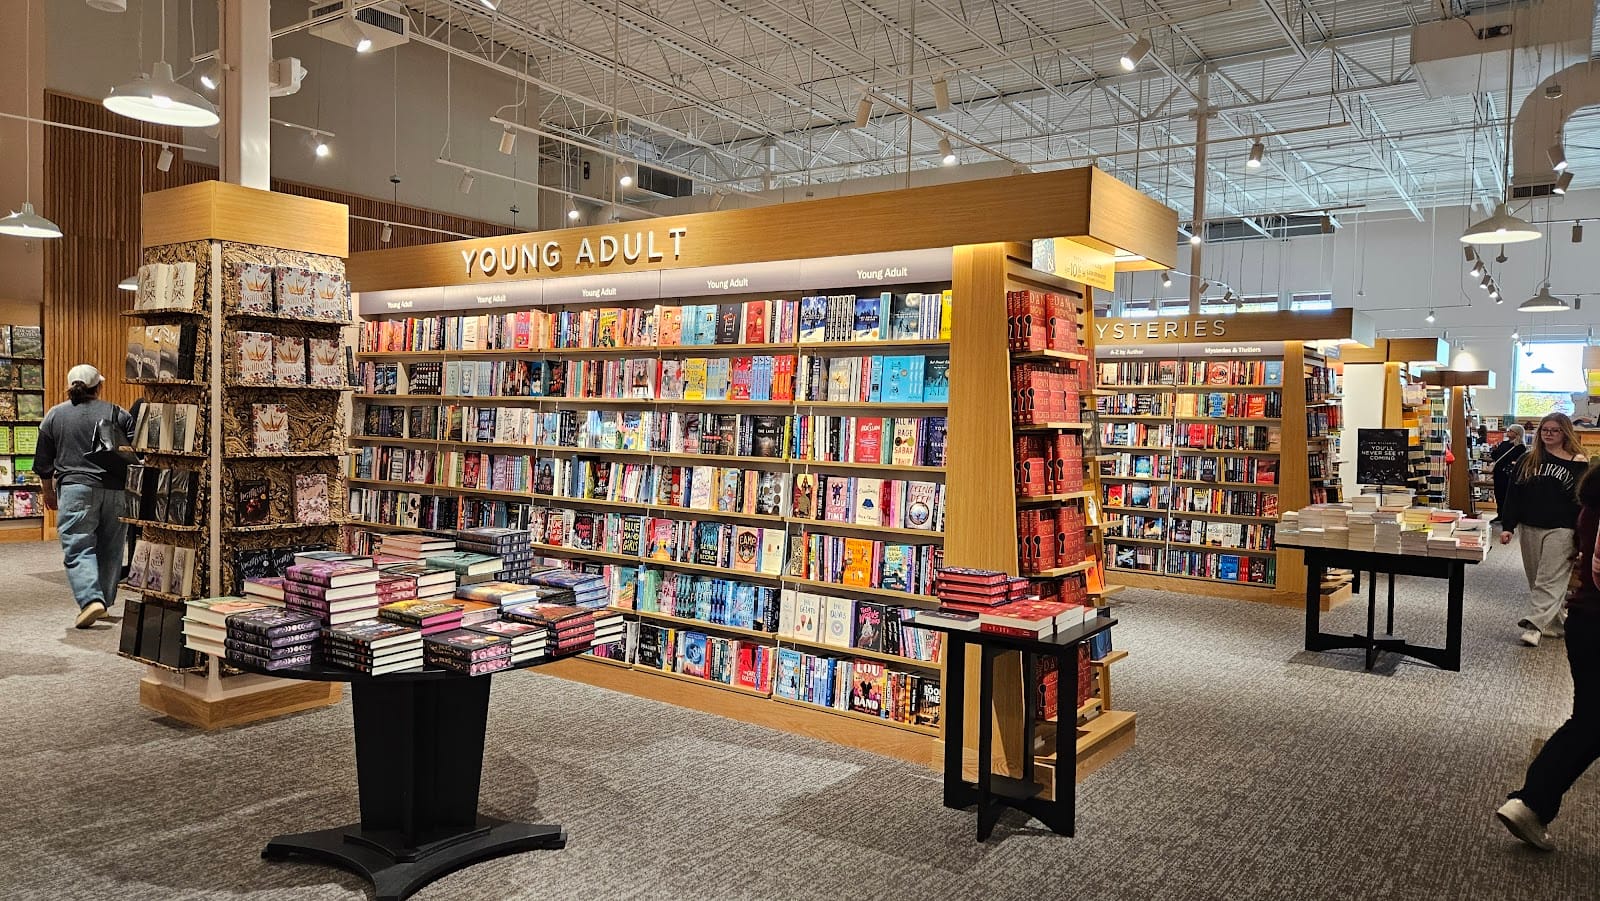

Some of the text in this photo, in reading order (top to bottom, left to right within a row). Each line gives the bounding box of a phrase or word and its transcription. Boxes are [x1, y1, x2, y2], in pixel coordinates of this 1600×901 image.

[461, 226, 688, 275] YOUNG ADULT
[857, 267, 908, 280] Young Adult
[706, 278, 749, 290] Young Adult
[476, 294, 507, 304] Young Adult
[582, 287, 617, 299] Young Adult
[1096, 319, 1226, 339] YSTERIES
[1204, 347, 1231, 356] Mysteries
[895, 417, 906, 426] ALL
[898, 429, 913, 438] RAGE
[827, 511, 844, 520] TIME
[622, 539, 639, 551] GIRLS
[855, 662, 881, 677] LOU
[853, 695, 879, 710] BAND
